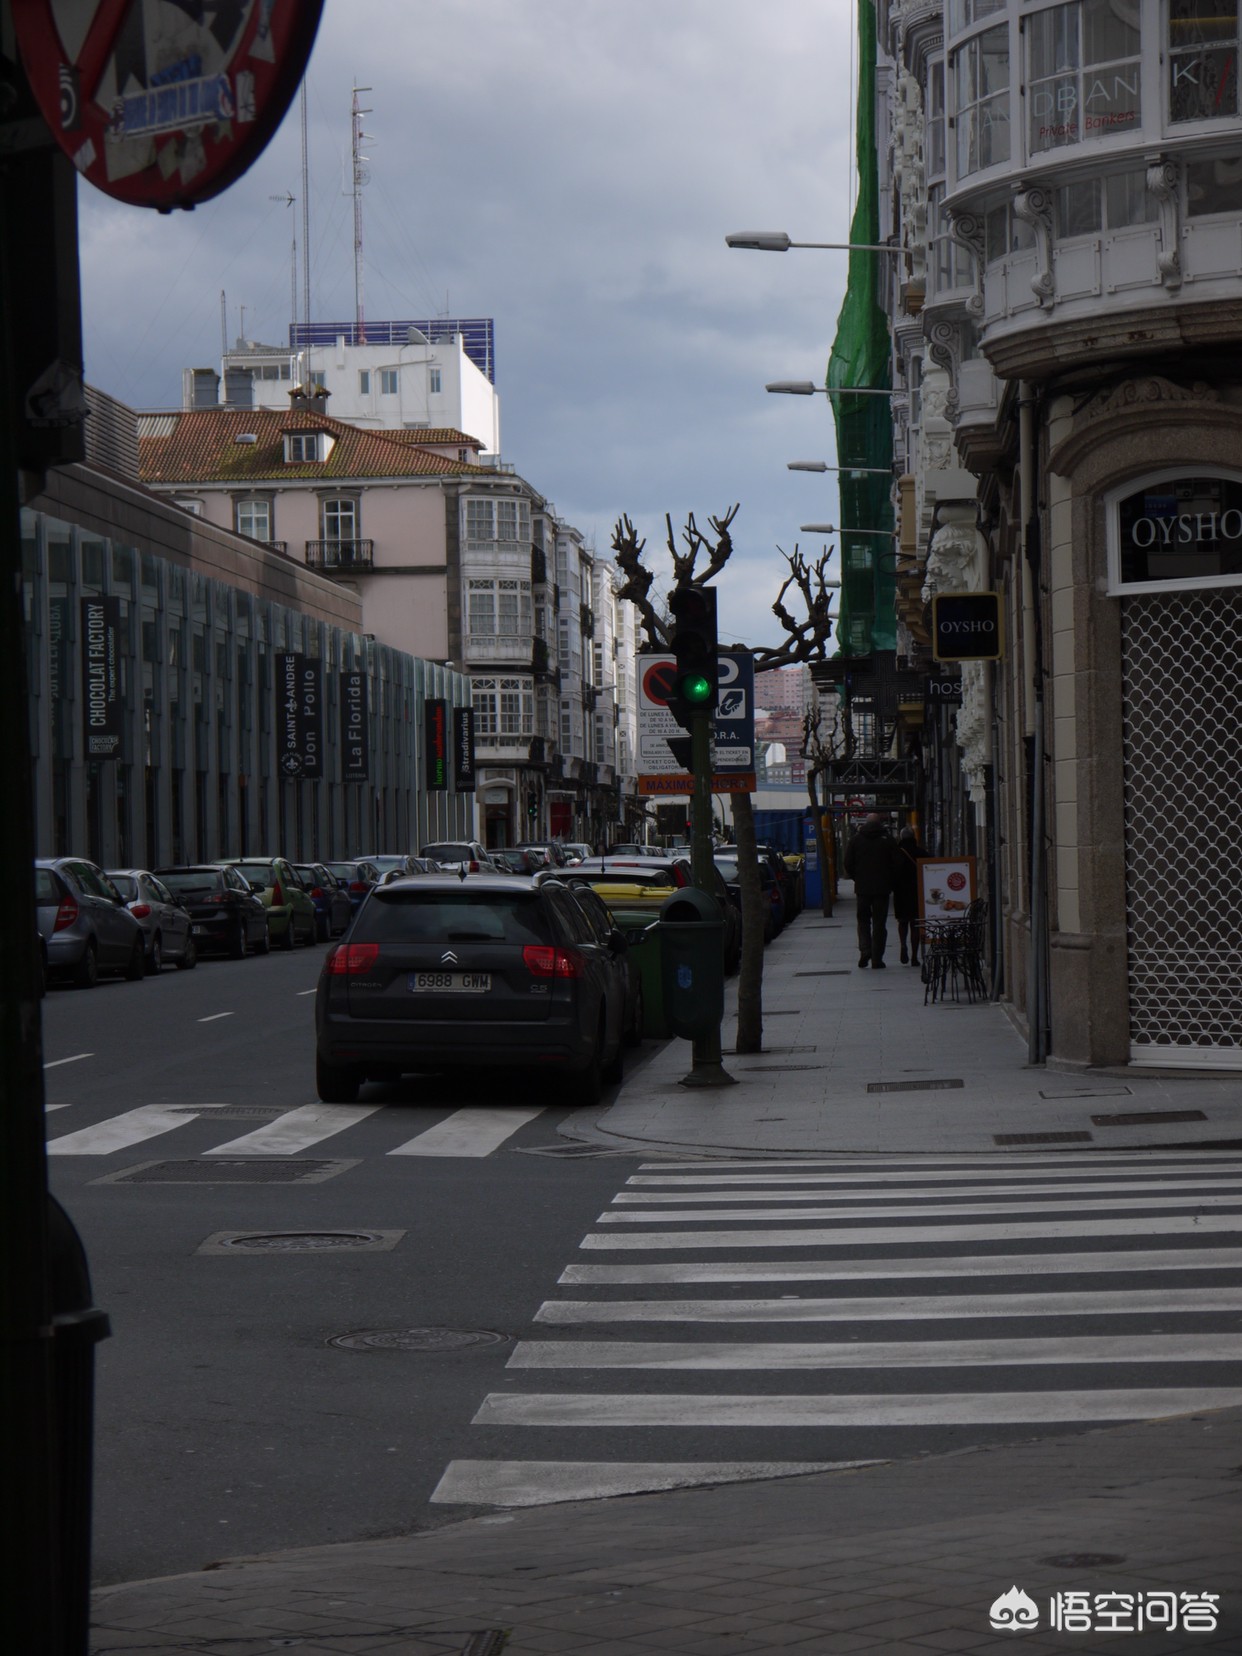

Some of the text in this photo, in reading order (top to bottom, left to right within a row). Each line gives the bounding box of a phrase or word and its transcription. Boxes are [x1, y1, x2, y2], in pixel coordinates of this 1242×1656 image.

[1039, 110, 1135, 139] Private Bankers
[1132, 509, 1242, 547] OYSHO
[940, 619, 994, 634] OYSHO
[87, 604, 107, 727] CHOCOLAT FACTORY
[108, 665, 117, 688] expert
[285, 656, 296, 698] ANDRE
[108, 688, 116, 702] The
[929, 680, 962, 695] hos
[287, 712, 296, 748] SAINT
[303, 670, 316, 766] Don Pollo
[347, 676, 362, 767] La Florida
[461, 712, 470, 773] Stradivarius
[418, 974, 489, 989] 6988 GWM
